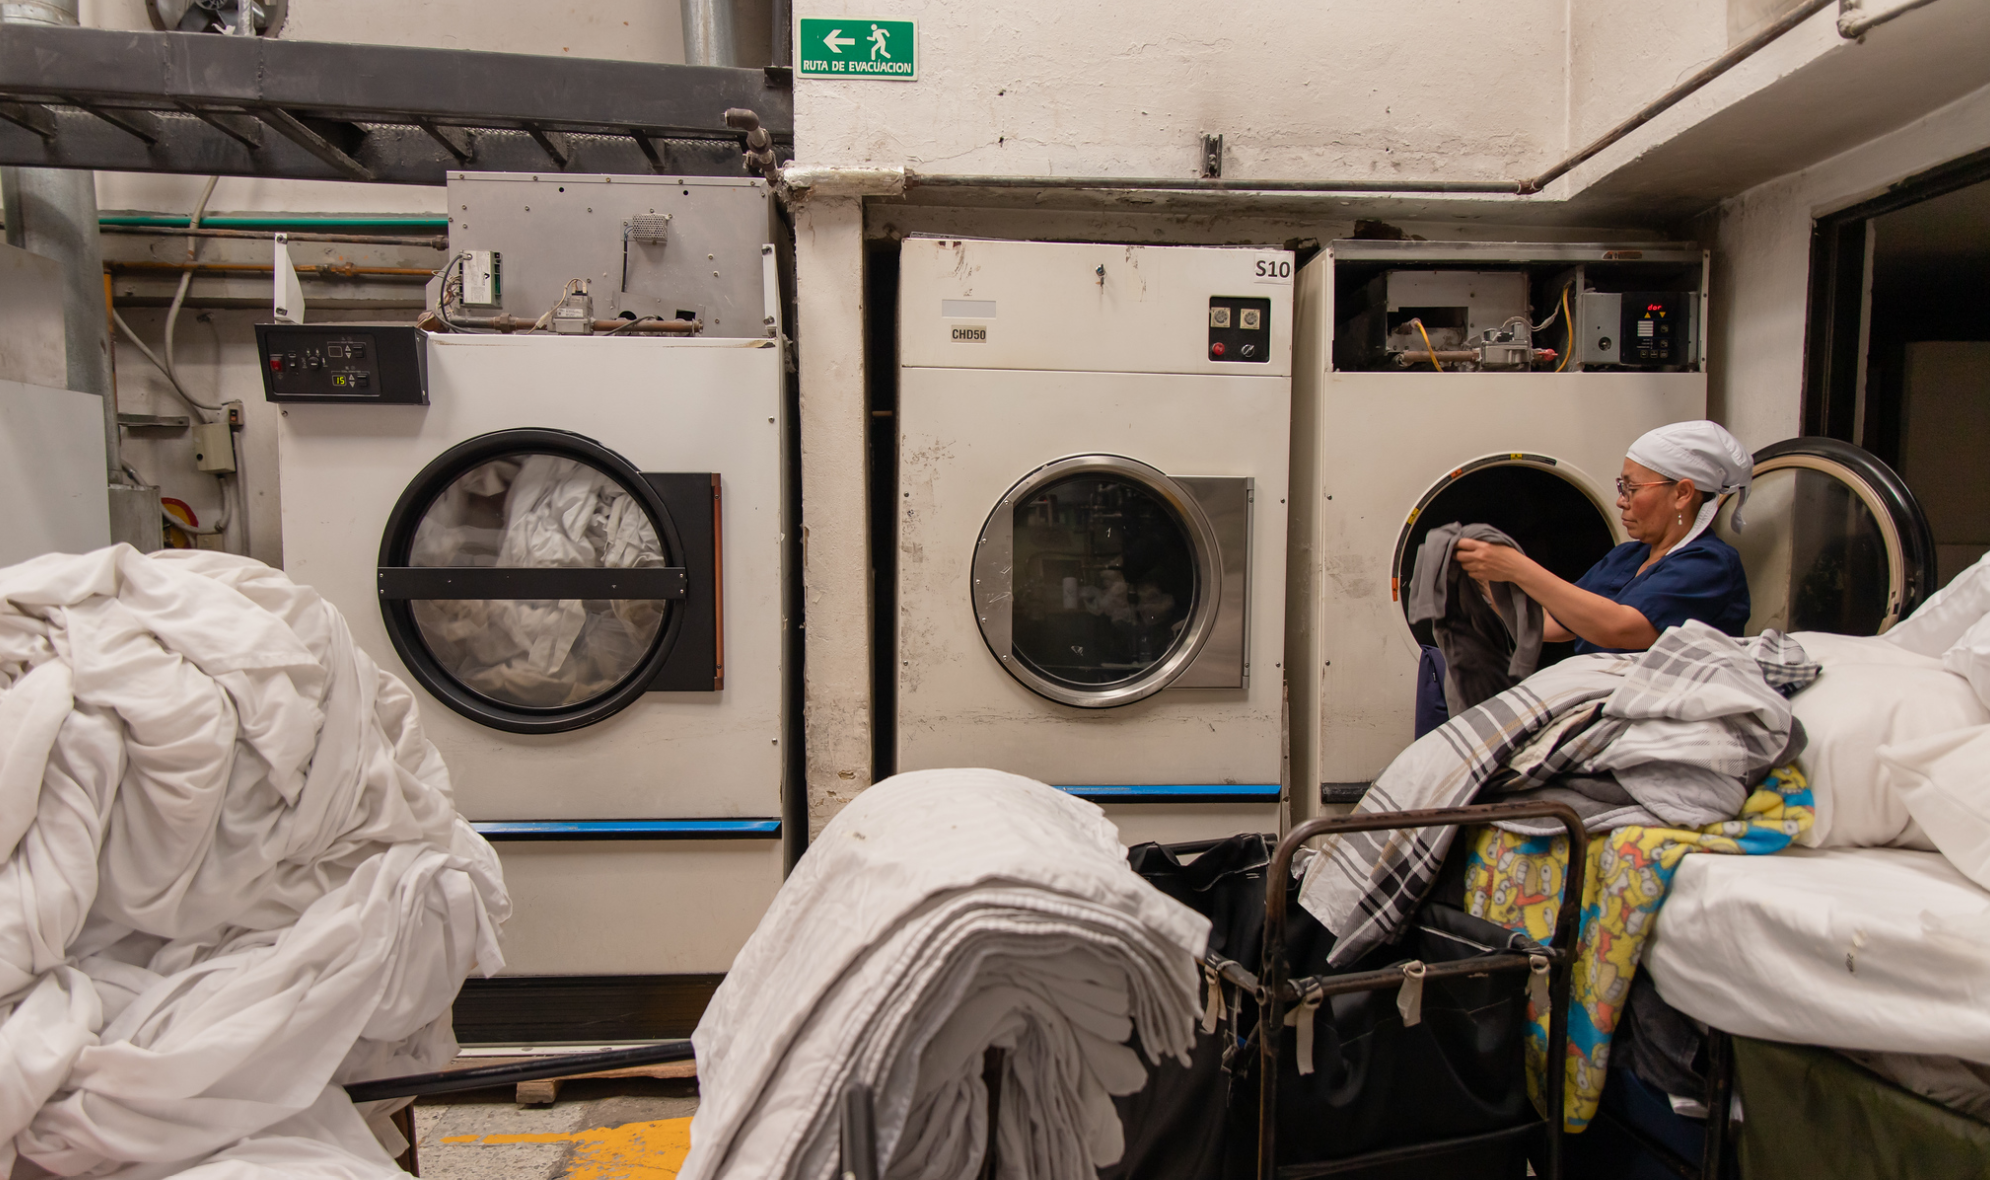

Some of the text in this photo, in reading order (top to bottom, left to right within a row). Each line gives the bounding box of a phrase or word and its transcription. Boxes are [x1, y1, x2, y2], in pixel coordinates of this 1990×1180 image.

[803, 60, 912, 74] RUTA DE EVACUACION
[1255, 260, 1291, 278] S10
[952, 328, 986, 340] CHD50
[336, 376, 345, 385] 15
